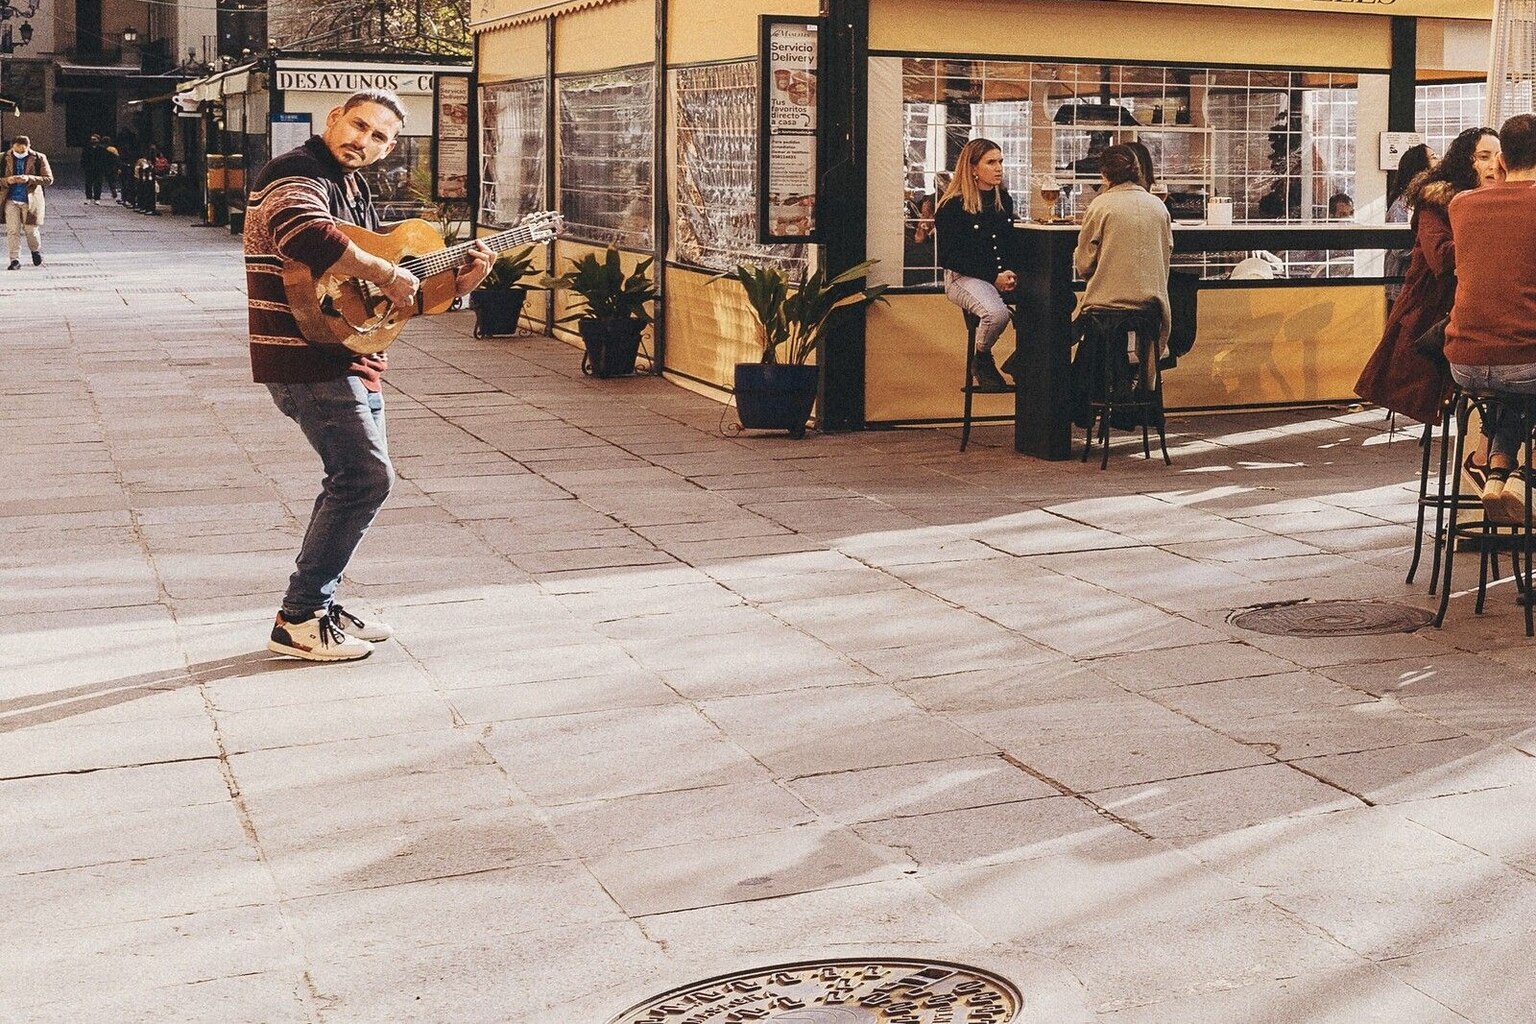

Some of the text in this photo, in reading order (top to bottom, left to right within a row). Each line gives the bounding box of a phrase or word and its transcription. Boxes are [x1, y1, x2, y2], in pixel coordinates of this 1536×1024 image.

[771, 41, 813, 53] Servicio
[771, 51, 815, 64] Delivery
[280, 73, 398, 91] DESAYUNOS
[771, 98, 786, 106] Tus
[771, 105, 807, 113] favoritos
